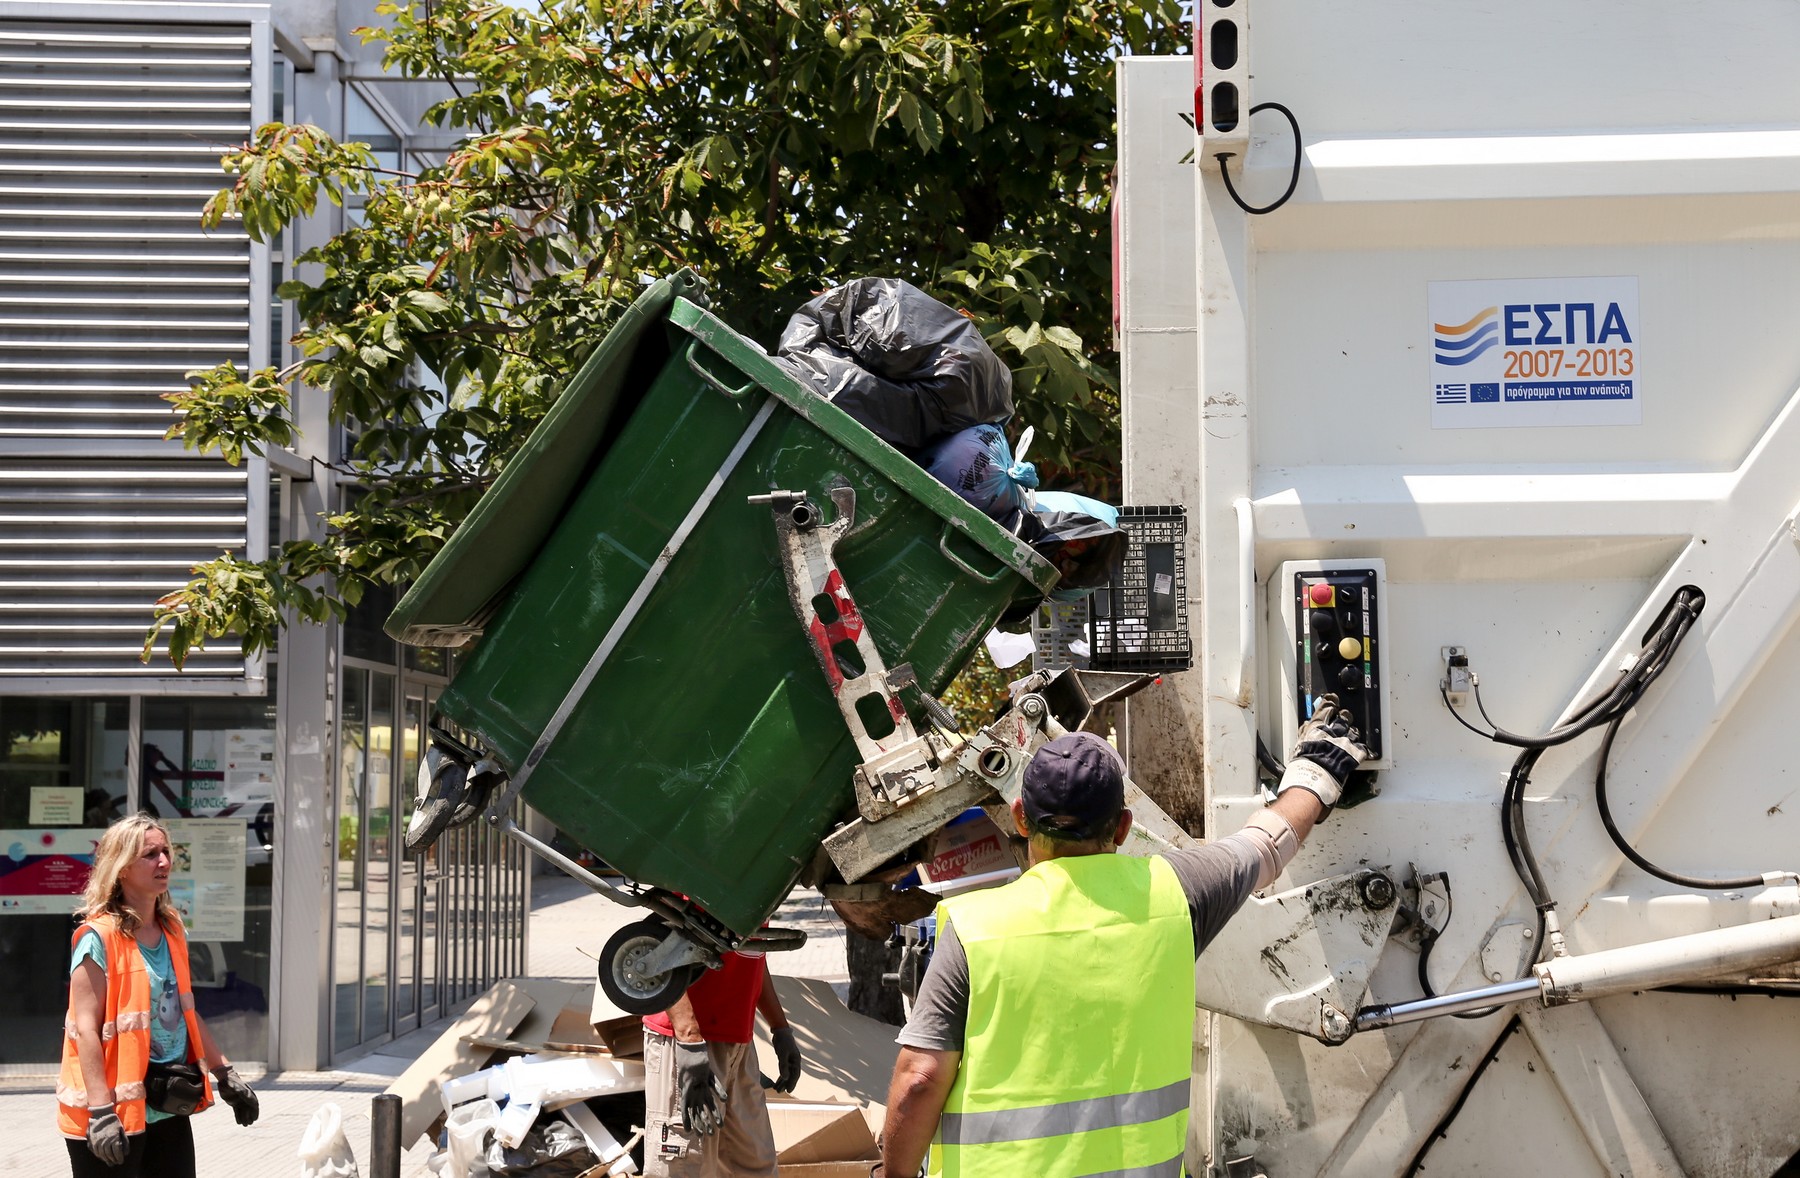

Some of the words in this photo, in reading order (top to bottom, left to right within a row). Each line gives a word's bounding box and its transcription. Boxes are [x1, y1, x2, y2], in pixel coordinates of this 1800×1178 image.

[1504, 302, 1633, 346] ΕΣΠΑ
[1503, 348, 1634, 378] 2007-2013
[1507, 384, 1555, 400] πρόγραμμα
[1557, 386, 1571, 399] για
[1573, 385, 1588, 398] την
[1590, 383, 1631, 397] ανάπτυξη
[931, 841, 996, 875] Serenata
